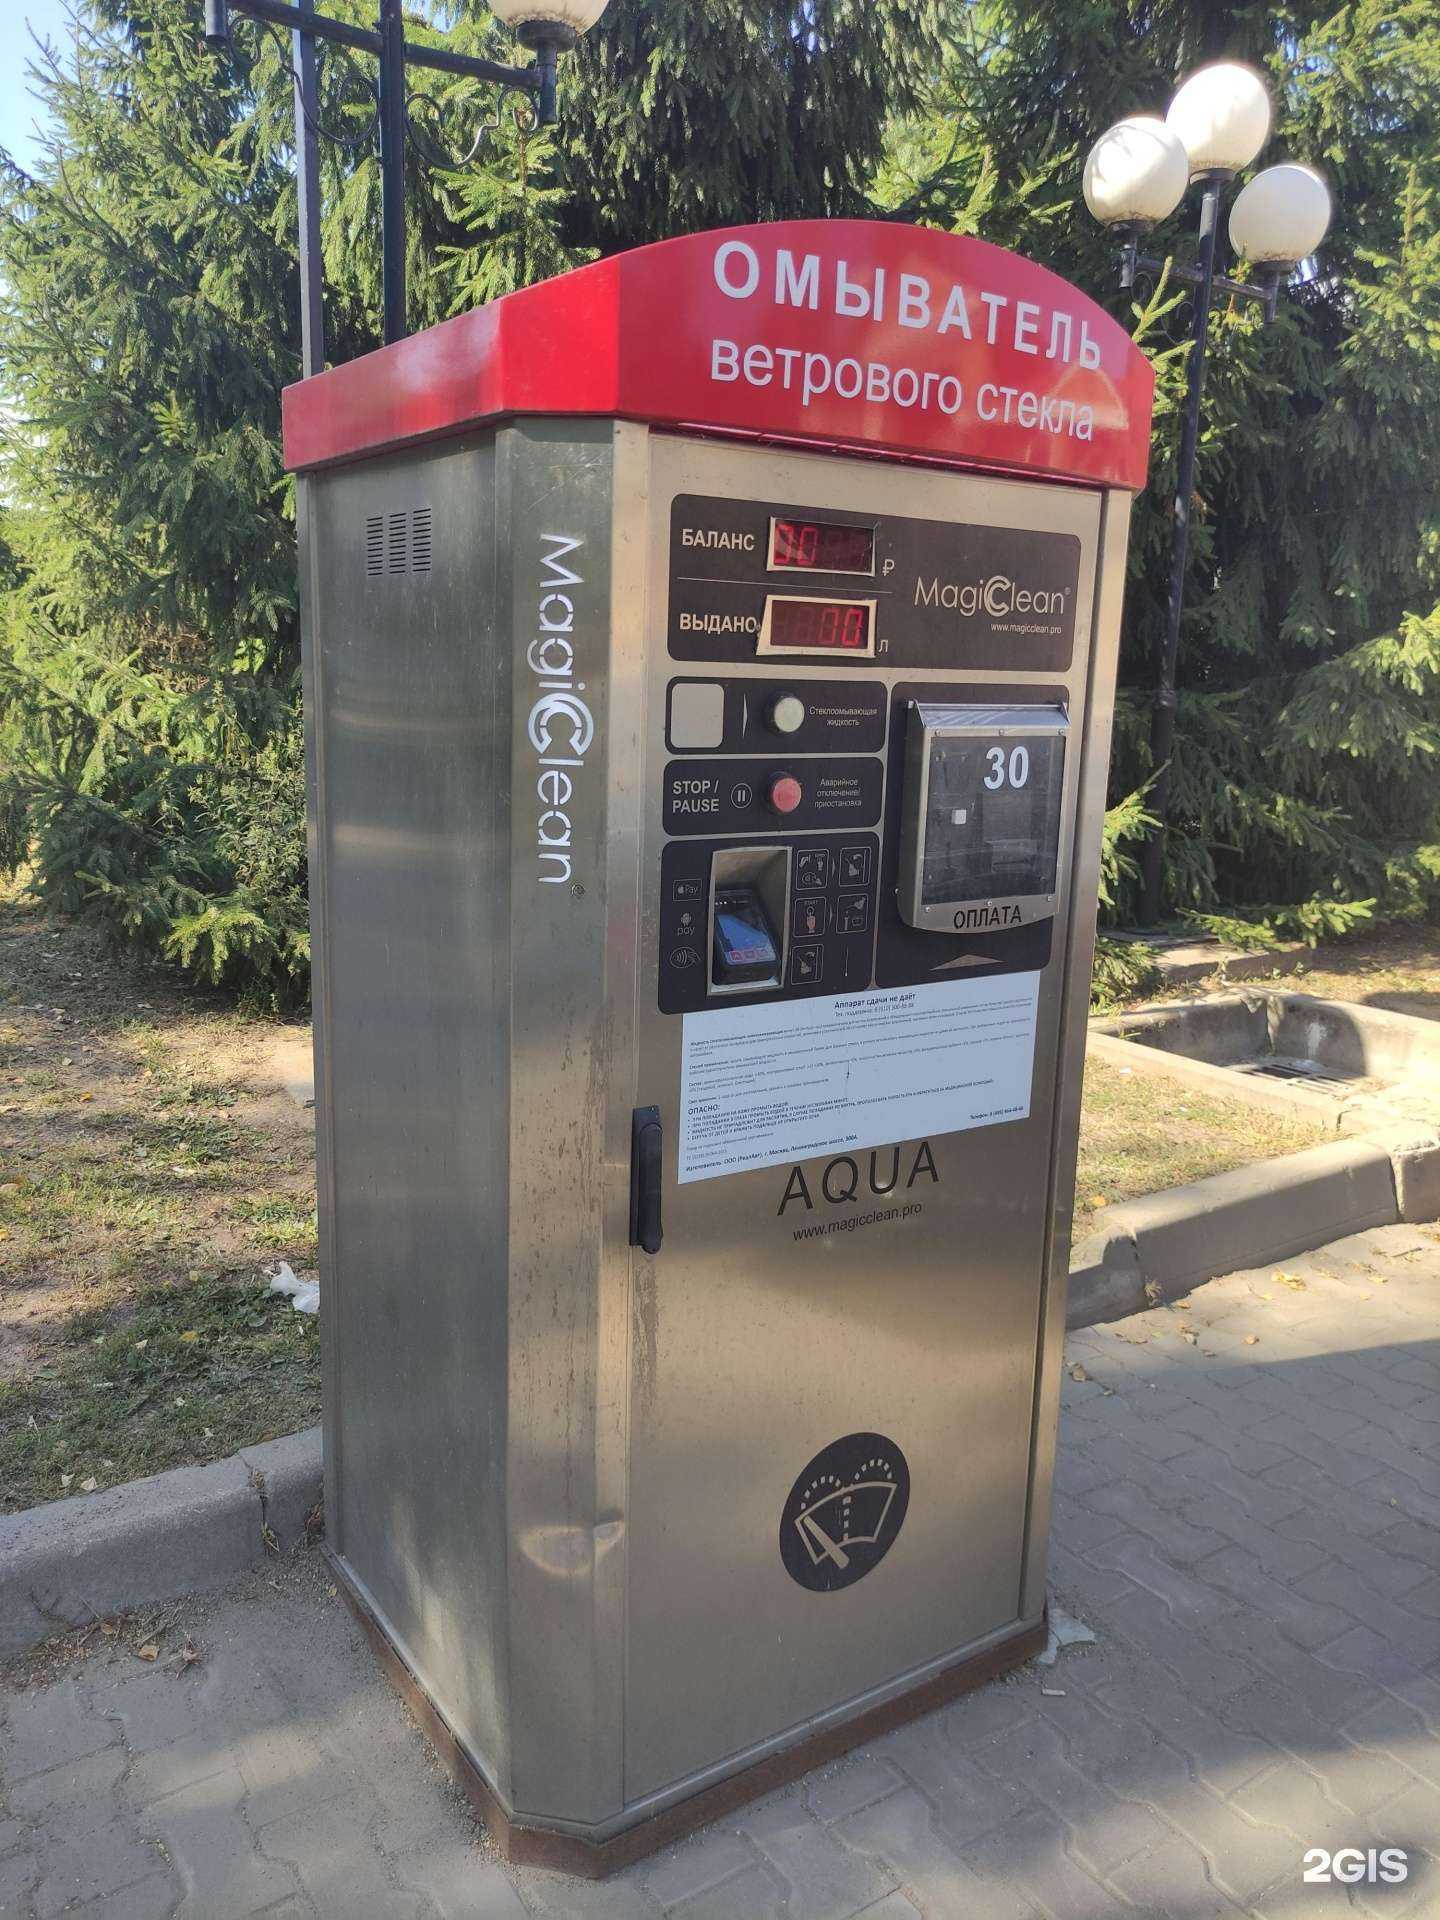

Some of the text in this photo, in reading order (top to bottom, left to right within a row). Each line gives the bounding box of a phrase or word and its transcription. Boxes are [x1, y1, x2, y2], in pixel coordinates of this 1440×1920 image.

[713, 240, 1101, 370] ОМЫВАТЕЛЬ
[711, 338, 1094, 441] ветрового стекла
[682, 528, 755, 551] БАЛАНС
[679, 613, 758, 635] ВЫДАНО
[991, 623, 1062, 635] www.magicclean.pro
[809, 706, 878, 717] Стеклоомывающая
[826, 717, 860, 727] жидкость
[983, 746, 1029, 790] 30
[820, 778, 859, 789] Аварийное
[672, 798, 720, 814] PAUSE
[814, 799, 862, 809] приостановка
[953, 904, 1022, 930] ОПЛАТА
[834, 999, 865, 1009] Аппарат
[867, 996, 888, 1007] сдачи
[899, 993, 916, 1002] даёт
[688, 1104, 721, 1116] ОПАСНО:
[777, 1141, 940, 1217] AQUA
[793, 1202, 923, 1241] www.magicclean.pro
